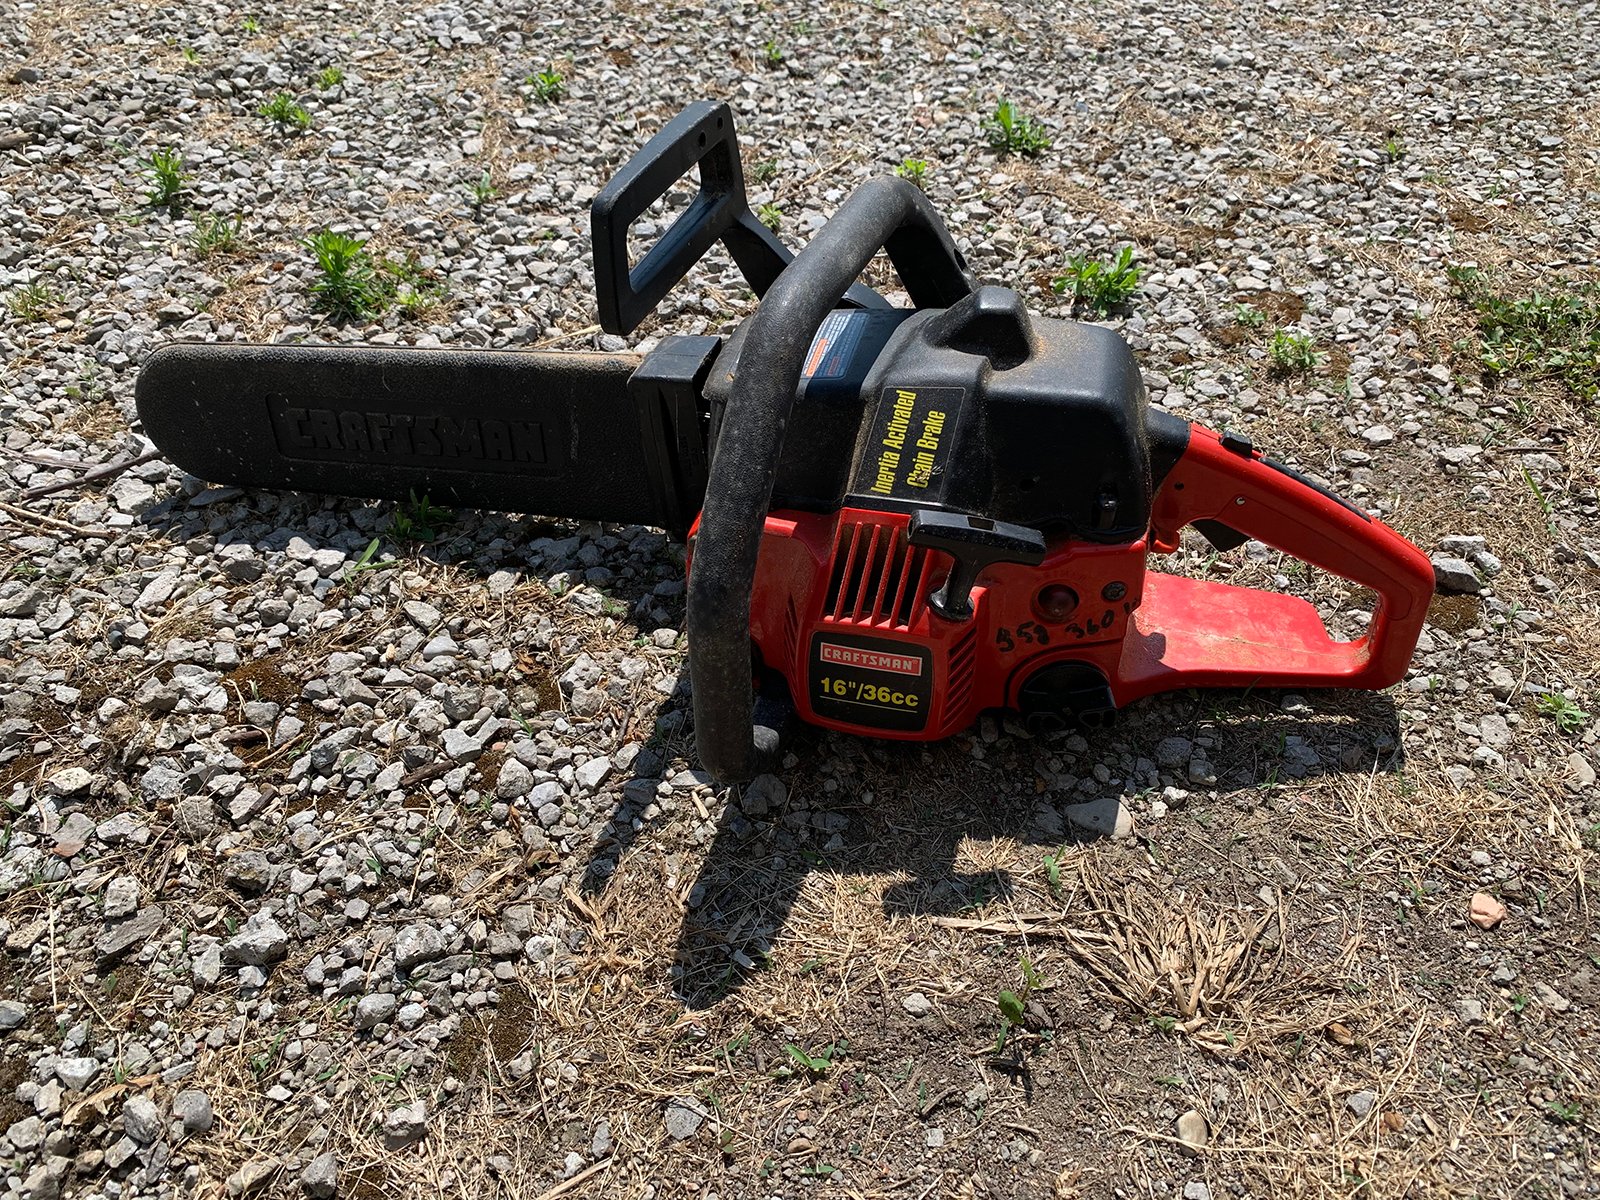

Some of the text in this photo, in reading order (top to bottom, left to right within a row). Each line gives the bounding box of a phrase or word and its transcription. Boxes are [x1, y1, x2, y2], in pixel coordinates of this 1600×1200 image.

[285, 406, 548, 464] CRAFTSMAN
[870, 389, 917, 495] Inertia Activated
[906, 410, 946, 489] Chain Brake
[822, 646, 914, 671] CRAFTSMAN
[820, 676, 920, 707] 16"/36cc
